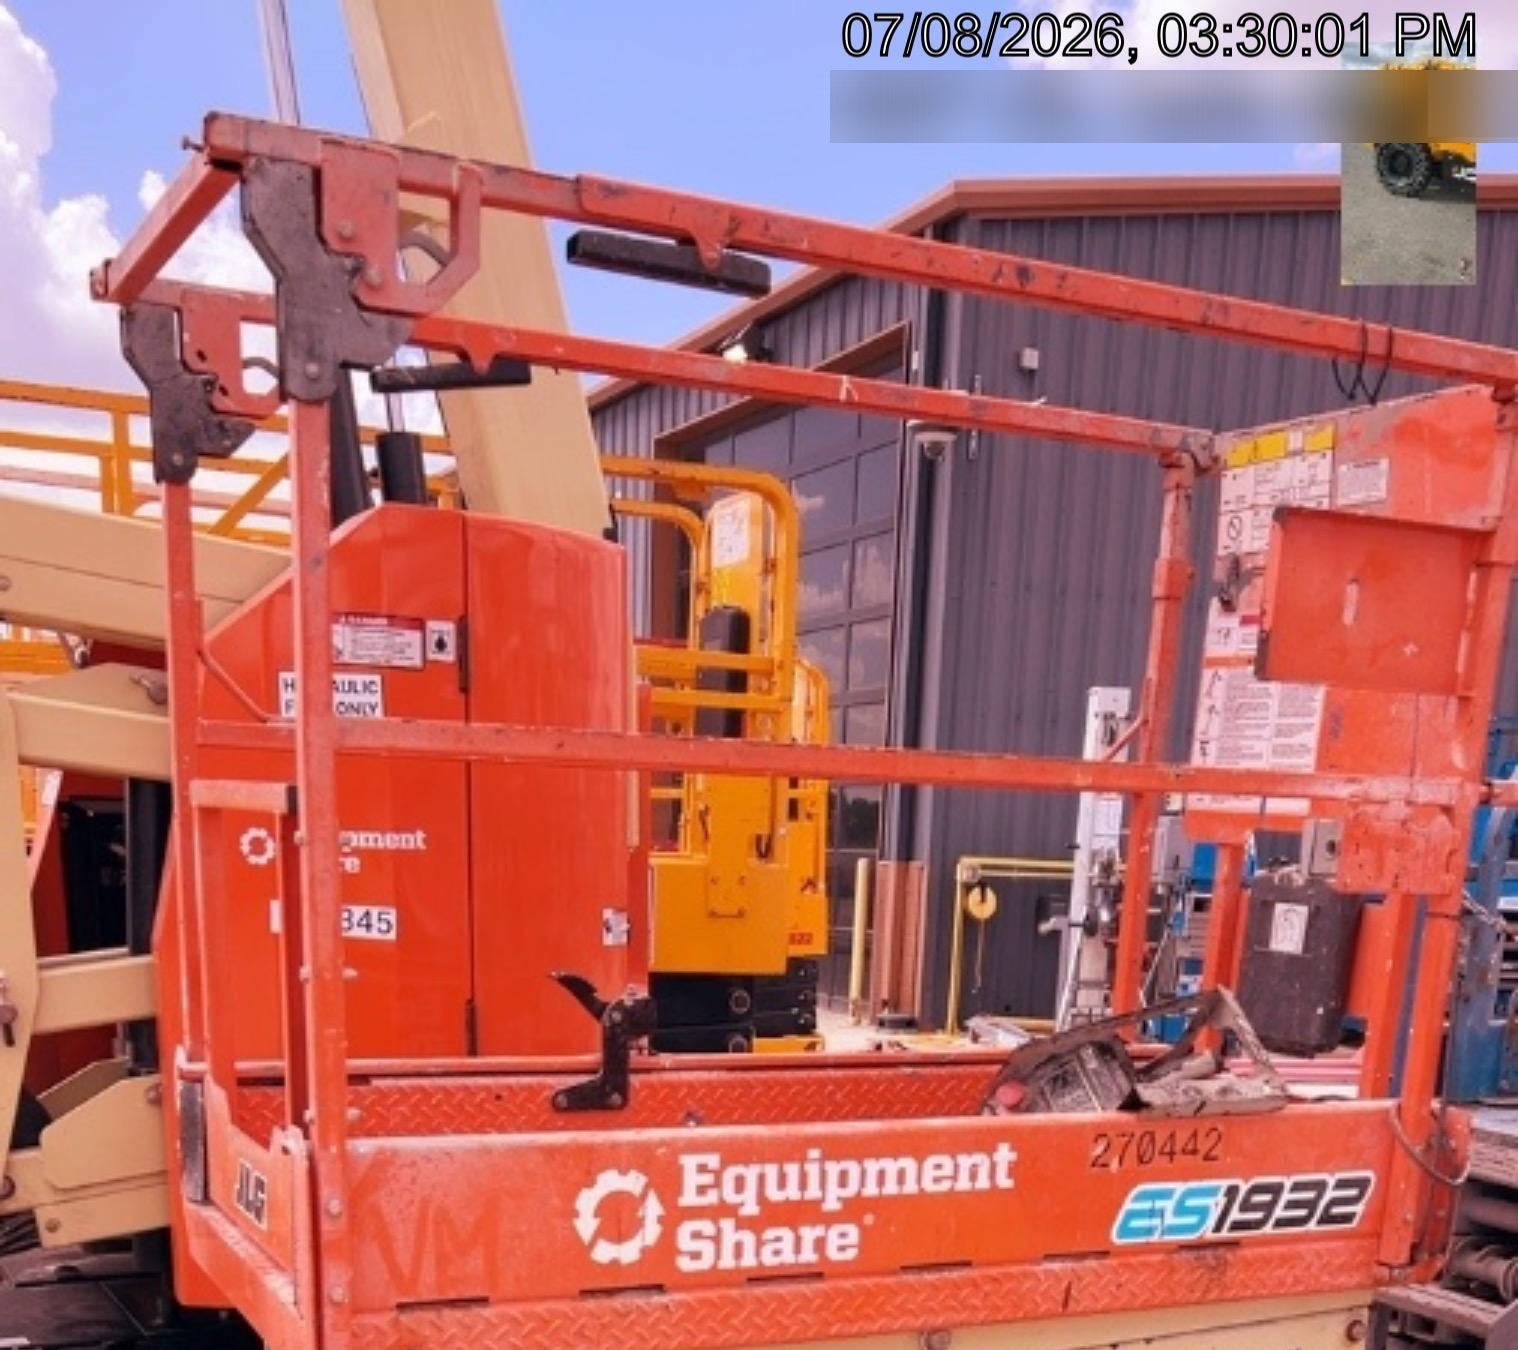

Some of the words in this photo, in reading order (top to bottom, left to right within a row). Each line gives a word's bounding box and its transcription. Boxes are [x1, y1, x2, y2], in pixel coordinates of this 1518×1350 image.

[677, 1142, 1018, 1216] Equipment
[1088, 1126, 1223, 1169] 270442
[1112, 1172, 1374, 1243] ES1932
[675, 1217, 860, 1272] Share
